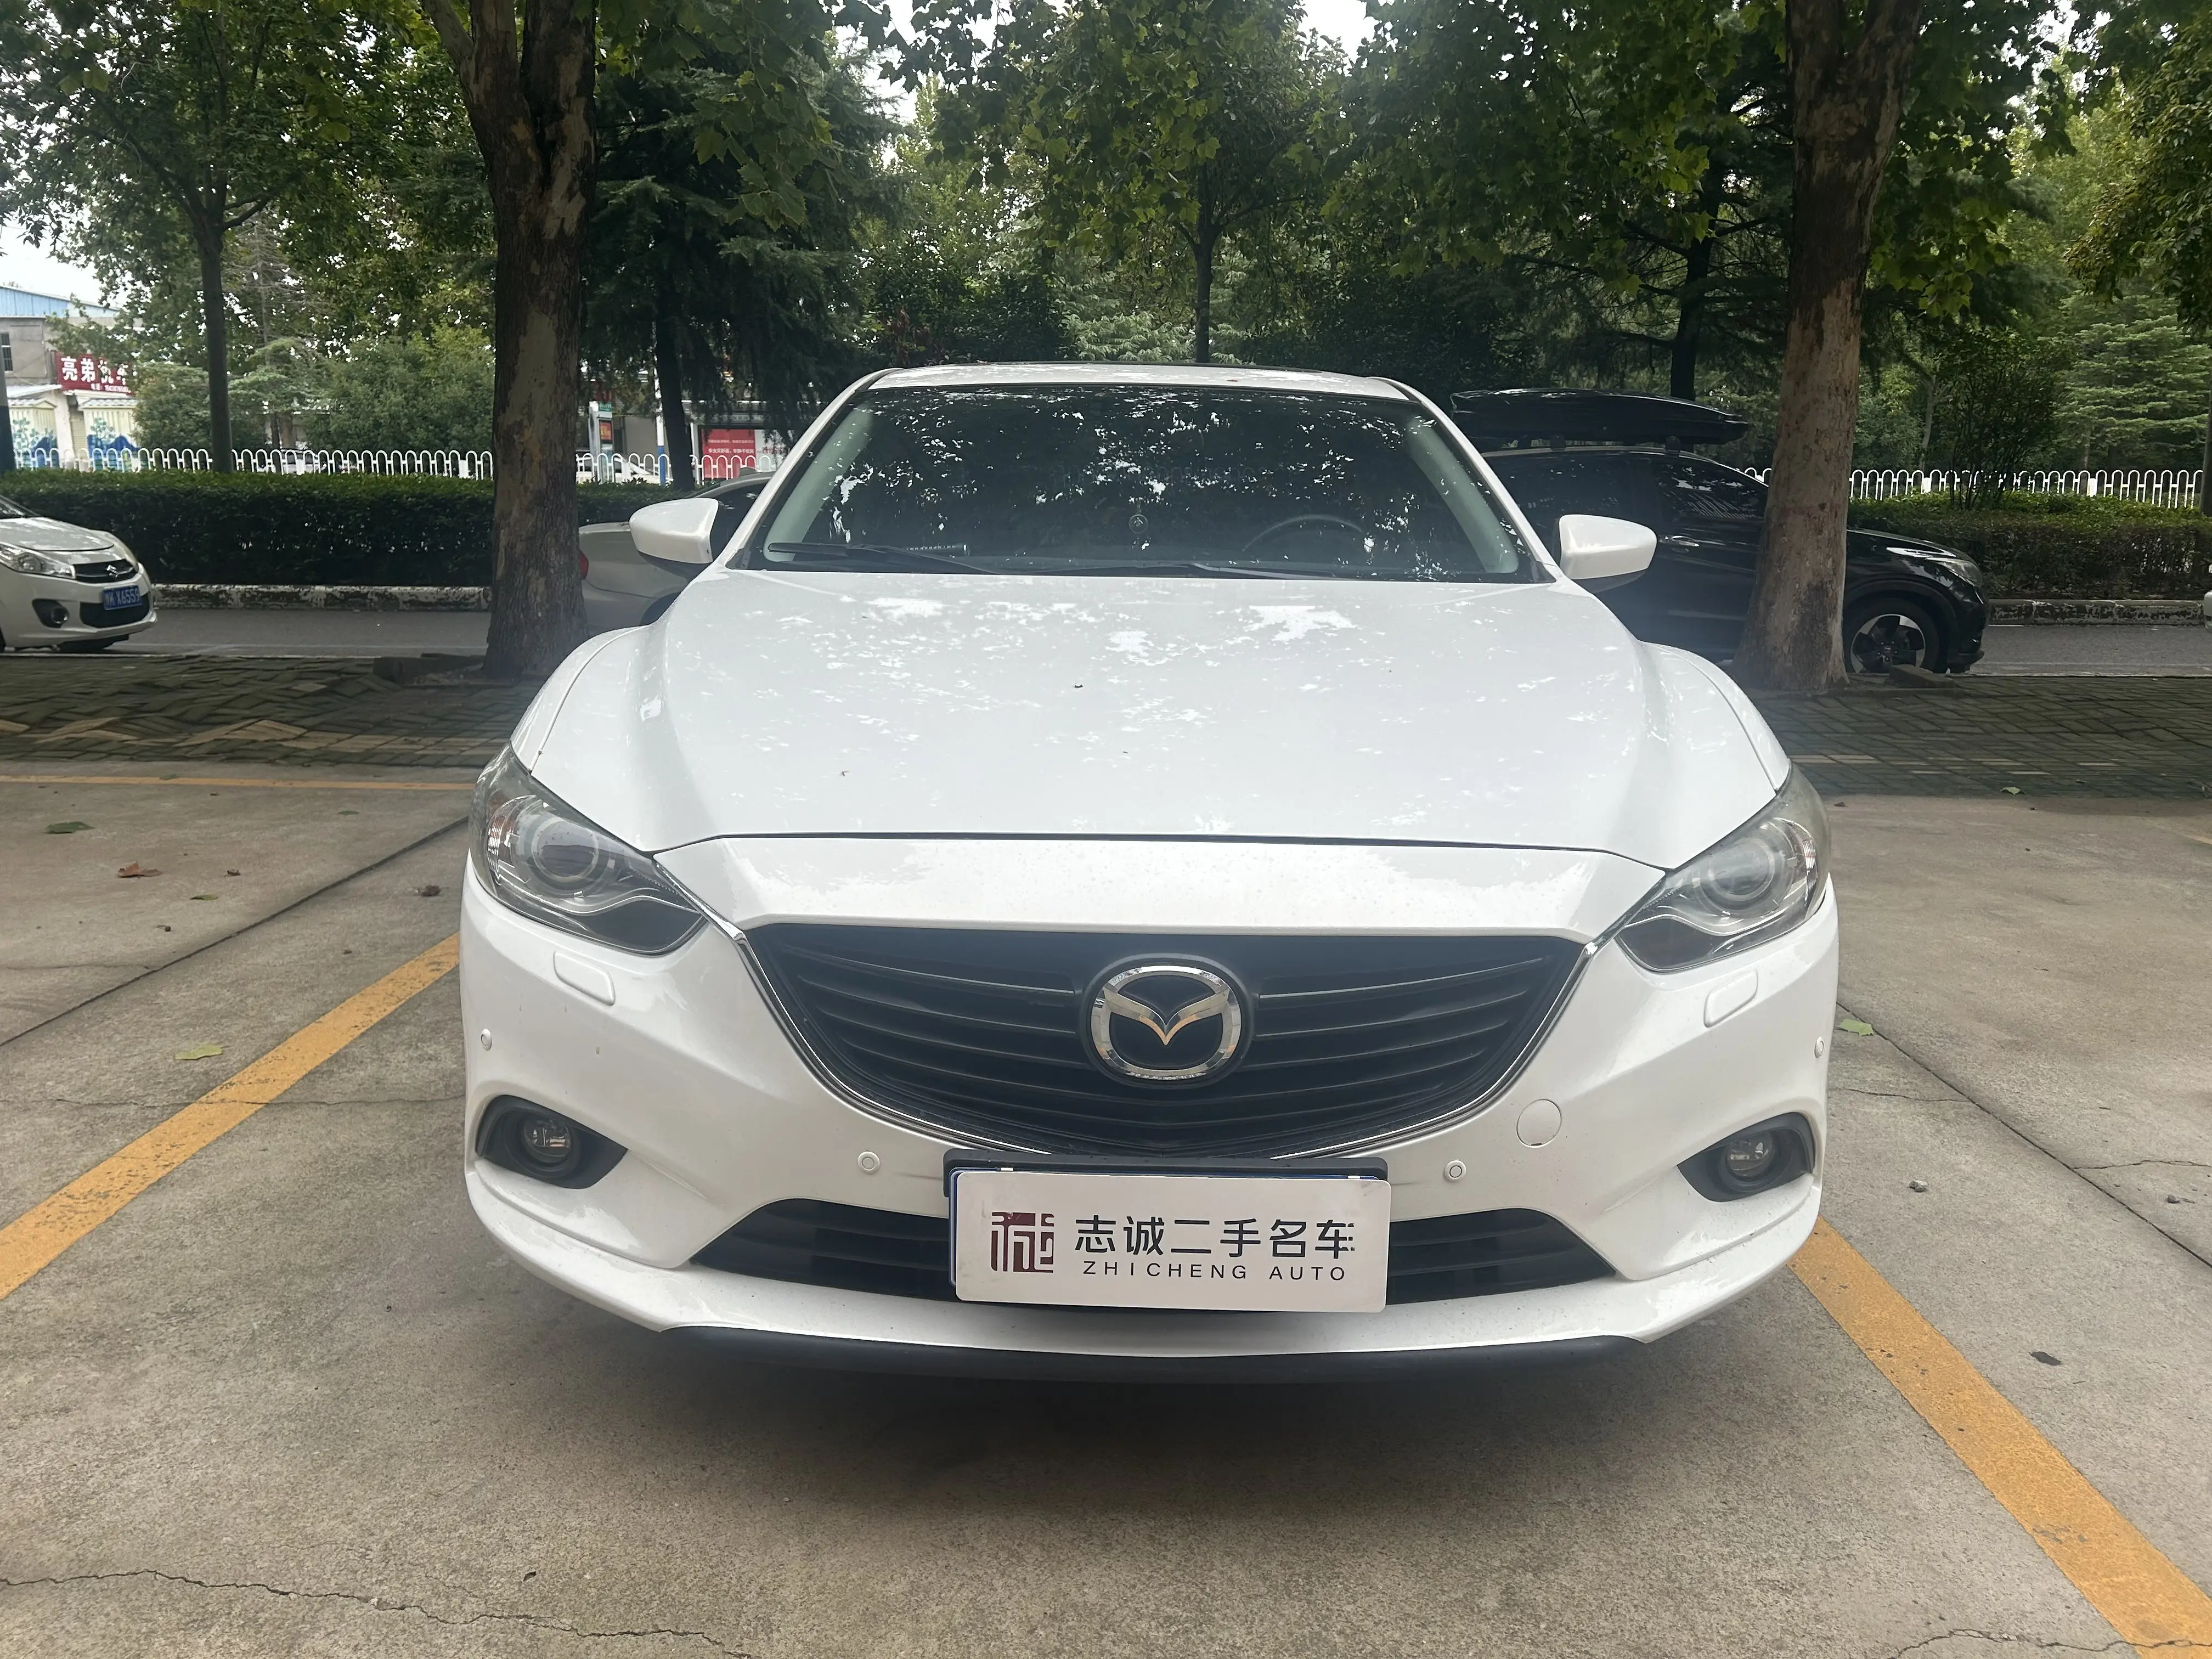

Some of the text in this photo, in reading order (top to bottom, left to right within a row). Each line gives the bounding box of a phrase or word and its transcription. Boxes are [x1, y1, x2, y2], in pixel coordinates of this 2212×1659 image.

[1075, 1214, 1355, 1260] 志诚二手名车
[1083, 1260, 1345, 1281] ZHICHENG AUTO
